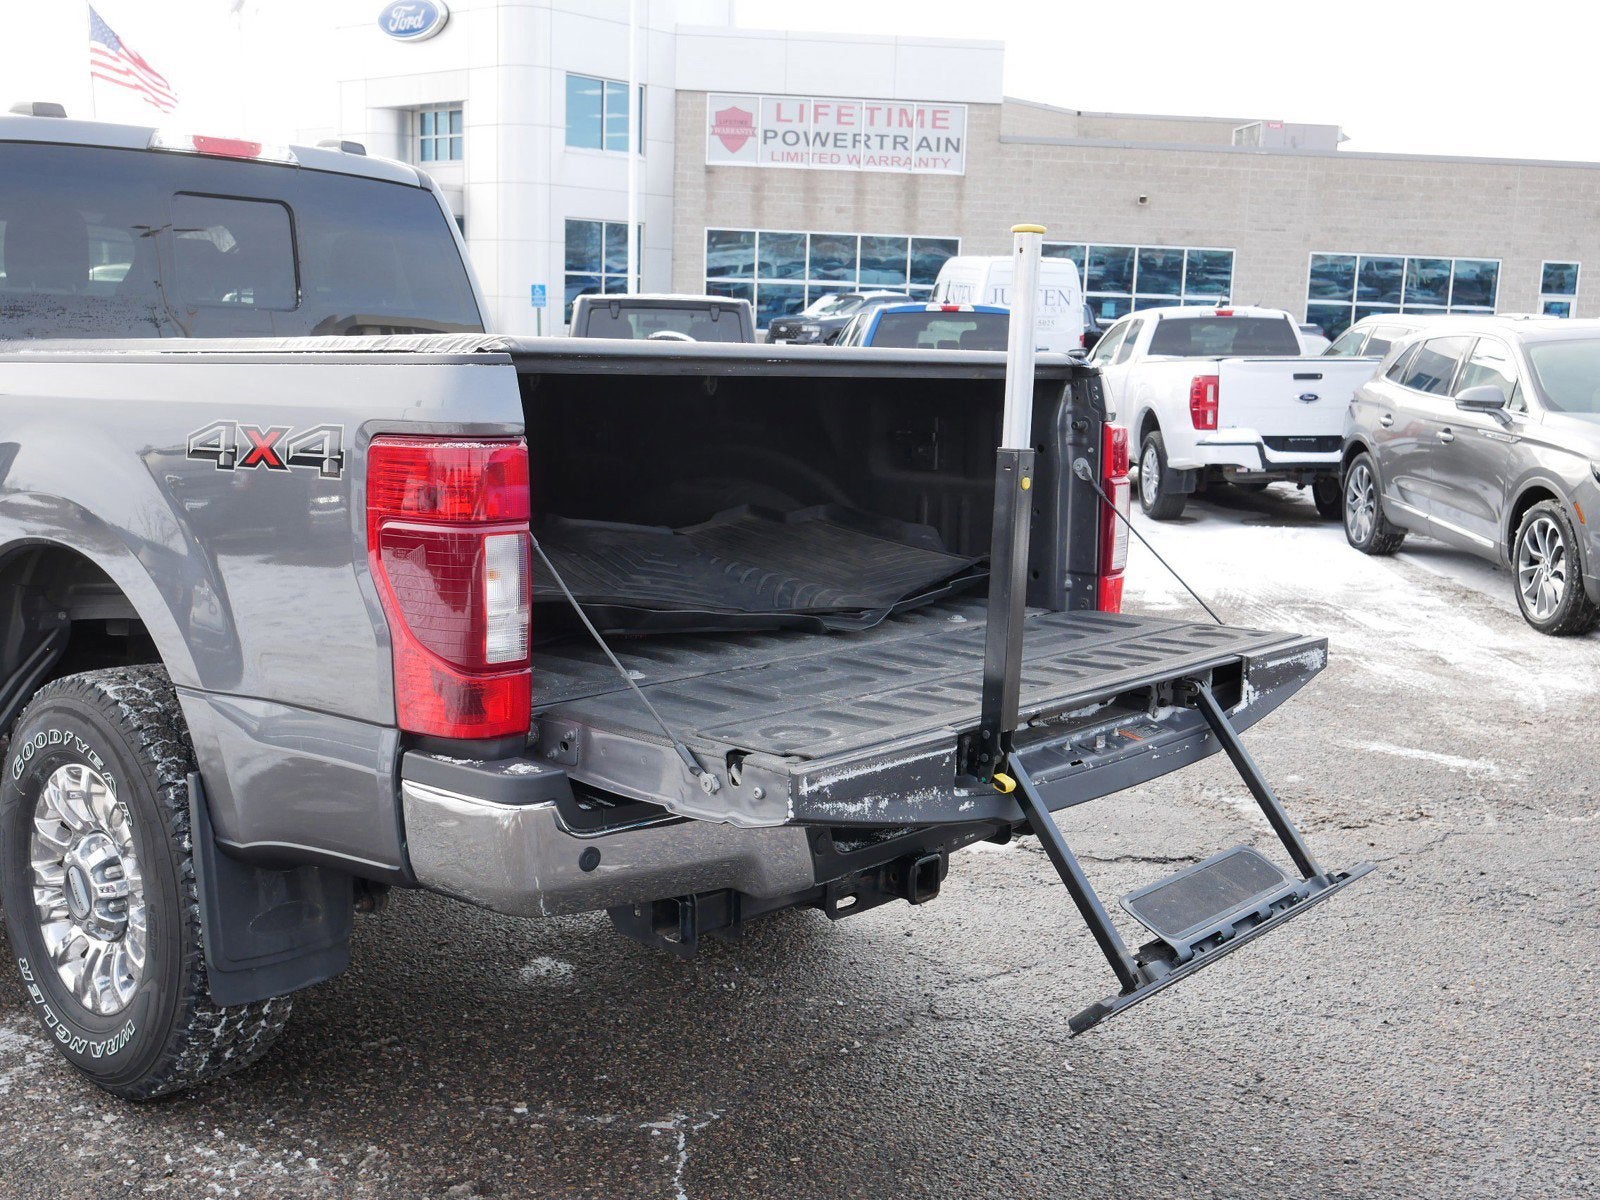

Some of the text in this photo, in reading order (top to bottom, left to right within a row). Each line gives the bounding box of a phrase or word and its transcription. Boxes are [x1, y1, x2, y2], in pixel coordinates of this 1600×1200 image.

[388, 5, 425, 31] Ford
[776, 102, 950, 130] LIFETIME
[763, 128, 961, 153] POWERTRAIN
[771, 151, 951, 168] LIMITED WARRANTY
[12, 729, 133, 827] GOODYEAR
[18, 957, 136, 1058] WRANGLER
